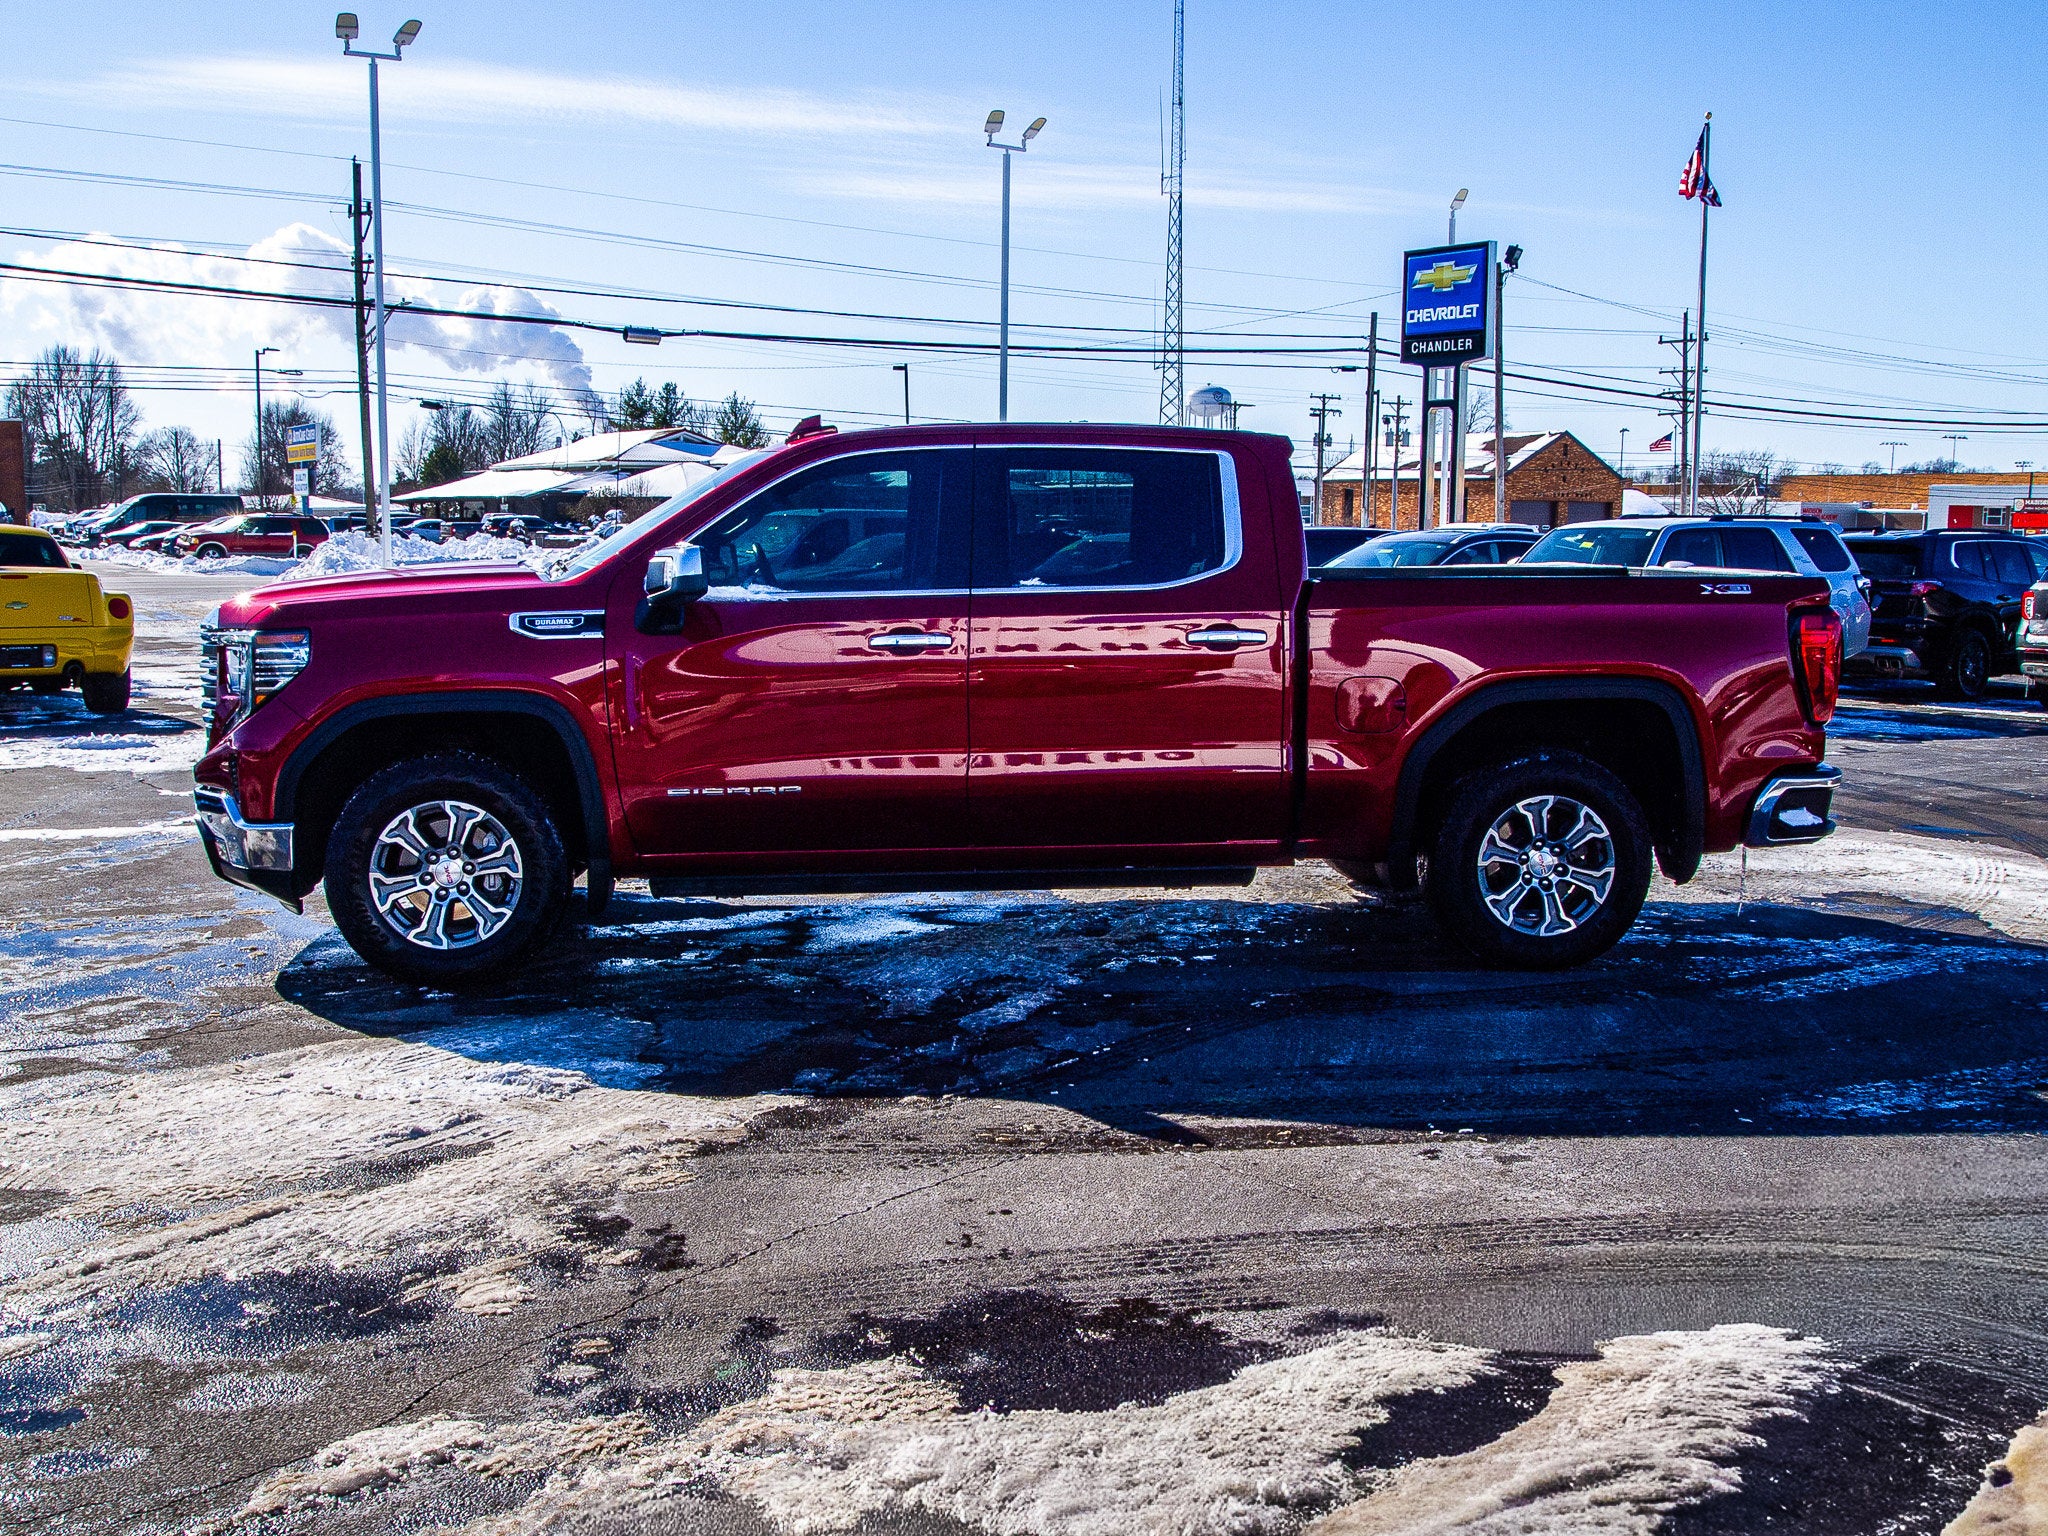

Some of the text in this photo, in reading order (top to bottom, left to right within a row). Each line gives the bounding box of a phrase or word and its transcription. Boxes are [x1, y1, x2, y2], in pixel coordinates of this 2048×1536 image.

[1406, 304, 1480, 324] CHEVROLET
[1411, 338, 1473, 354] CHANDLER
[535, 618, 574, 626] DURAMAX
[667, 786, 802, 796] SIERRA
[443, 865, 454, 884] GMC
